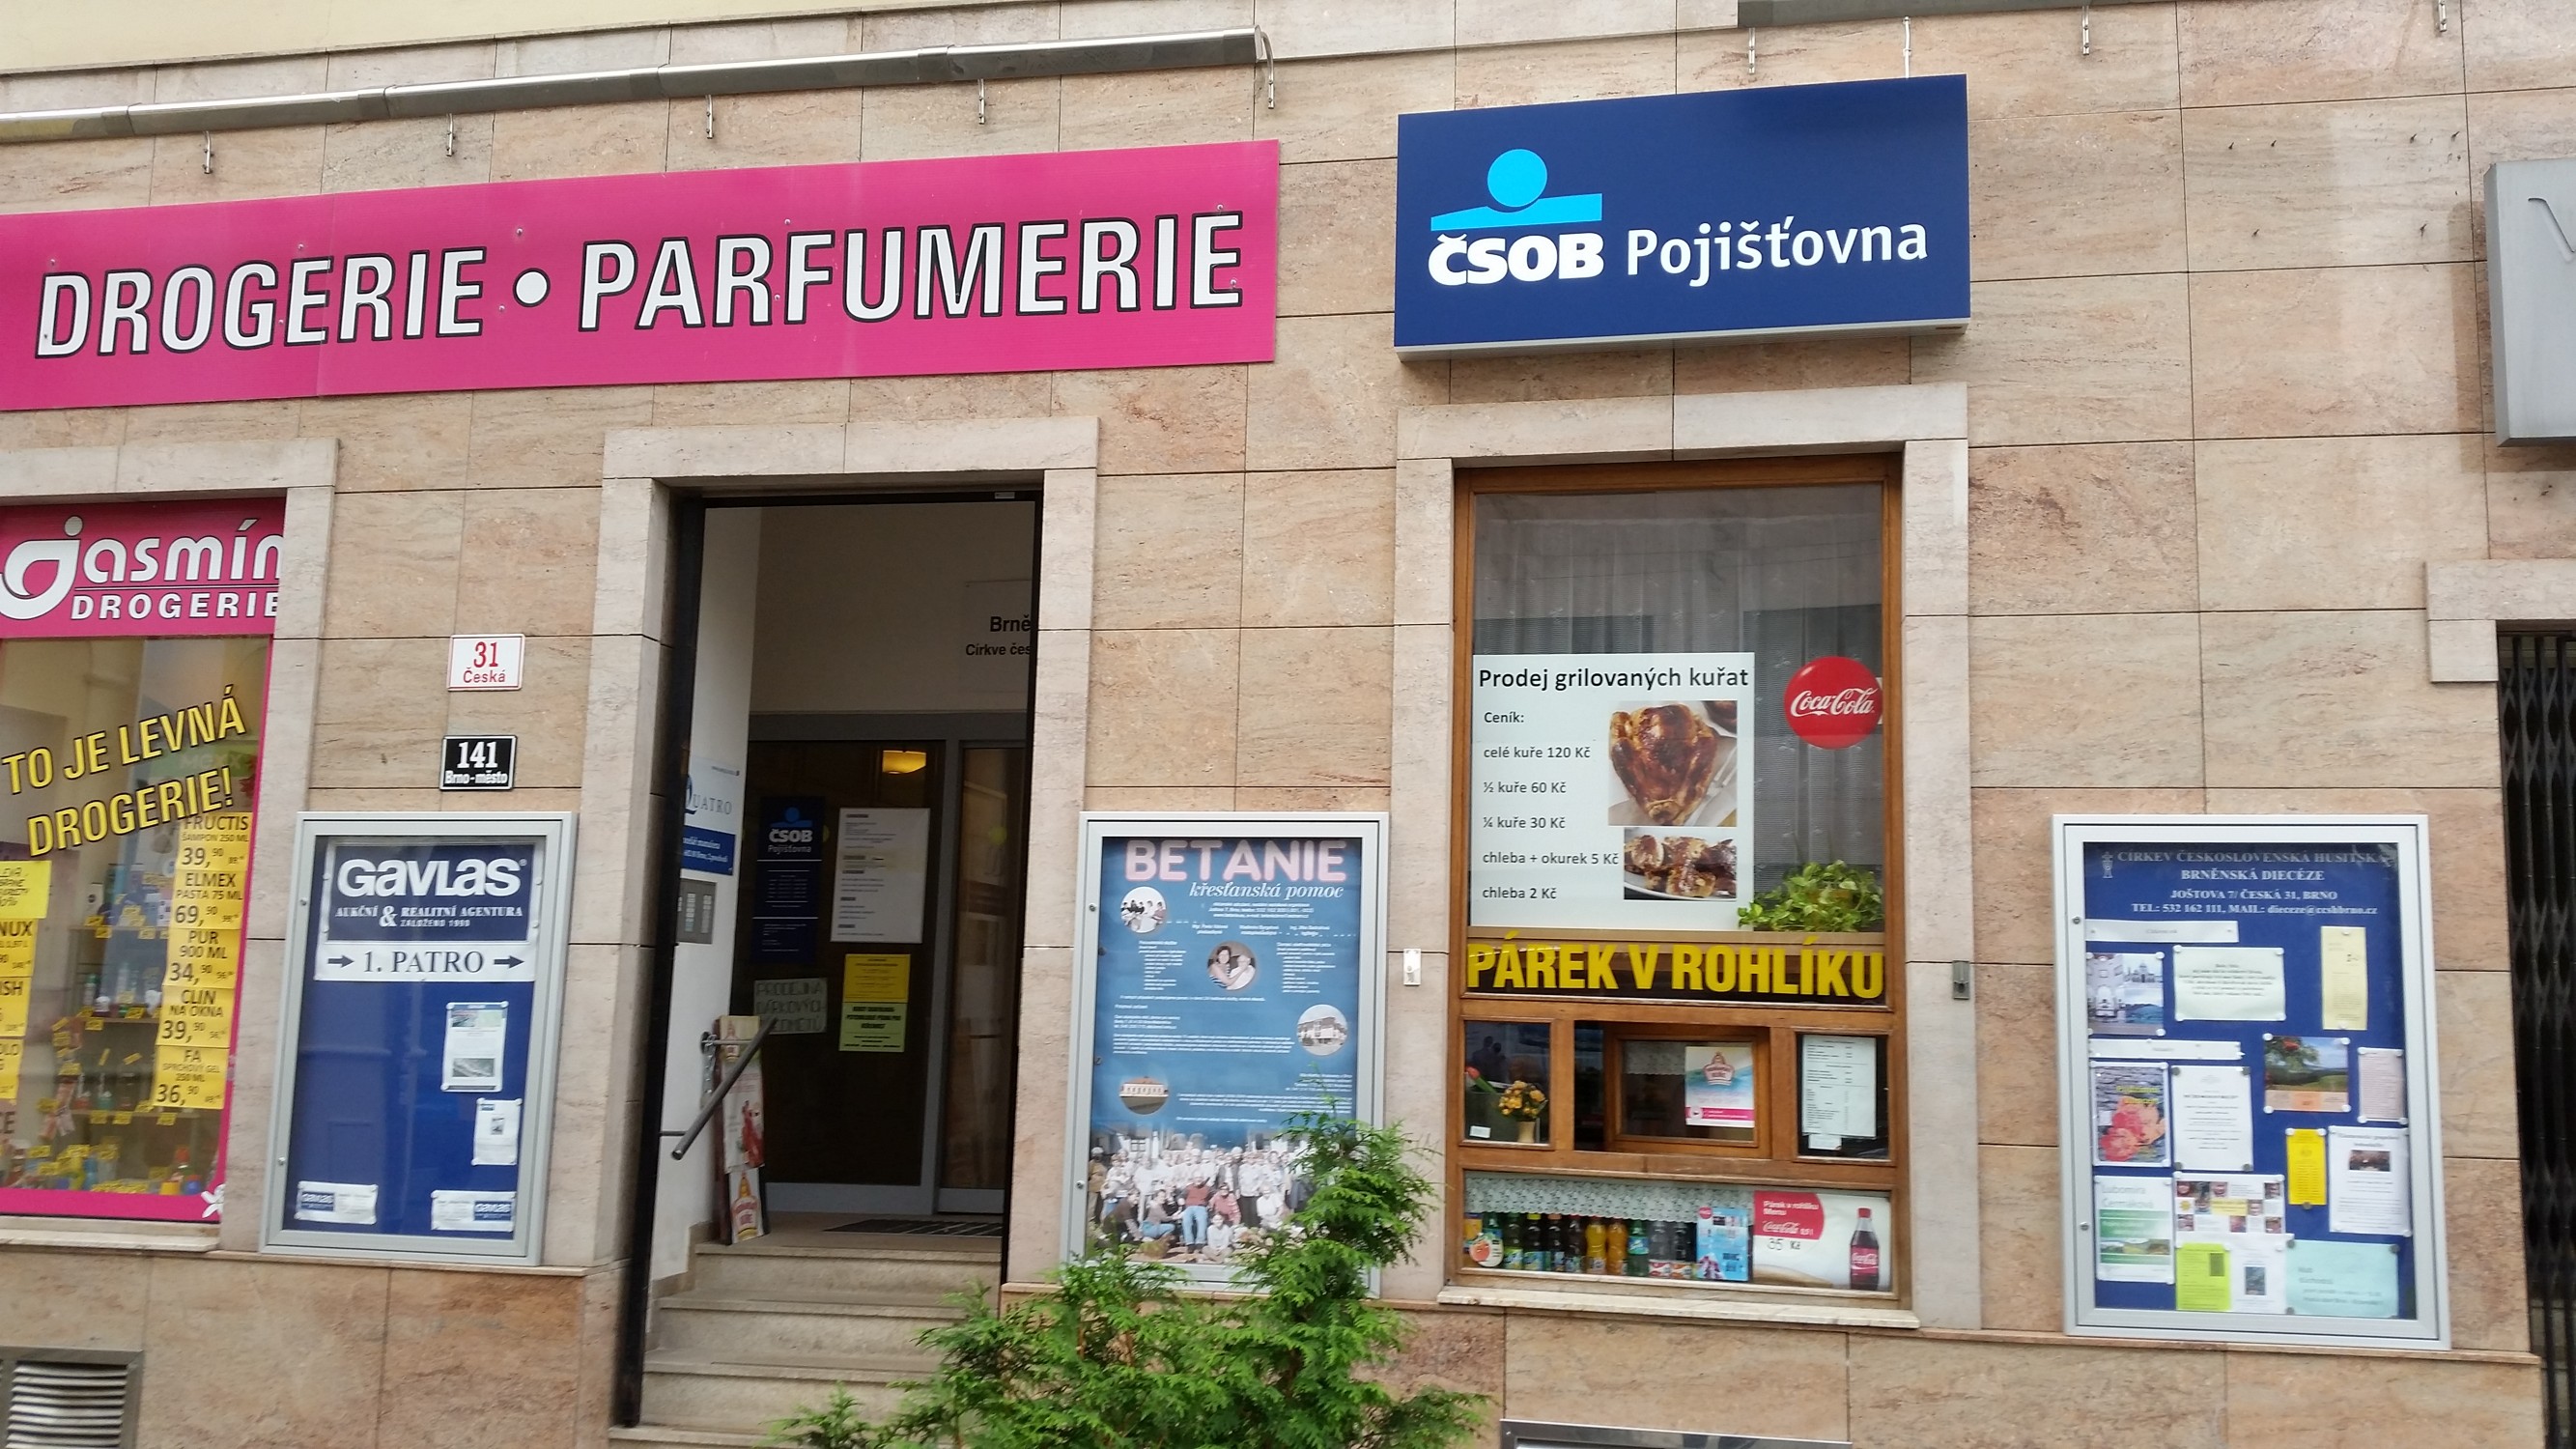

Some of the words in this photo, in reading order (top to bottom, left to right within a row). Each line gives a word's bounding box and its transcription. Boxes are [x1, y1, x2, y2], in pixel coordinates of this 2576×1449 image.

[1429, 233, 1604, 286] ČSOB
[1628, 216, 1928, 287] Pojišťovna
[35, 245, 486, 358] DROGERIE
[578, 211, 1243, 331] PARFUMERIE
[71, 591, 278, 620] DROGERIE
[473, 641, 499, 668] 31
[463, 668, 506, 684] Česká
[1479, 668, 1549, 692] Prodej
[1555, 667, 1682, 692] grilovaných
[1689, 667, 1749, 687] kuřat
[1791, 688, 1879, 717] Coca-Cola
[1484, 711, 1524, 724] Ceník:
[2, 746, 53, 795] TO
[64, 731, 110, 781] JE
[118, 684, 247, 766] LEVNÁ
[457, 741, 498, 769] 141
[1484, 747, 1511, 758] celé
[1514, 747, 1543, 758] kuře
[1547, 747, 1571, 758] 120
[1575, 746, 1592, 758] Kč
[1498, 781, 1527, 793] kuře
[1531, 781, 1547, 793] 60
[1551, 781, 1567, 793] Kč
[27, 766, 235, 857] DROGERIE!
[184, 815, 249, 831] FRUCTIS
[1497, 816, 1526, 828] kuře
[1530, 817, 1546, 828] 30
[1550, 816, 1566, 828] Kč
[769, 828, 813, 842] ČSOB
[1125, 838, 1348, 882] BETANIE
[1483, 852, 1526, 863] chleba
[1542, 852, 1588, 864] okurek
[1591, 853, 1599, 864] 5
[1603, 852, 1619, 864] Kč
[2117, 849, 2172, 862] CÍRKEV
[2175, 849, 2311, 864] ČESKOSLOVENSKÁ
[185, 872, 237, 887] ELMEX
[2180, 867, 2259, 880] BRNĚNSKÁ
[2261, 867, 2326, 881] DIECÉZE
[176, 889, 210, 899] PASTA
[212, 890, 224, 899] 75
[226, 891, 243, 900] ML
[1189, 881, 1282, 898] křesťanská
[1284, 885, 1345, 901] pomoc
[1483, 887, 1526, 898] chleba
[1529, 888, 1538, 898] 2
[1542, 887, 1557, 898] Kč
[2169, 888, 2226, 899] JOŠTOVA
[2239, 888, 2282, 900] ČESKÁ
[2302, 891, 2338, 900] BRNO
[379, 905, 399, 927] &
[400, 904, 457, 918] REALITNÍ
[460, 906, 524, 918] AGENTURA
[2162, 903, 2182, 913] 532
[2184, 903, 2203, 913] 162
[187, 930, 219, 945] PUR
[180, 945, 203, 958] 900
[207, 947, 228, 959] ML
[364, 952, 382, 973] 1.
[390, 950, 486, 974] PATRO
[1467, 930, 1620, 990] PÁREK
[1628, 943, 1660, 990] V
[1671, 935, 1885, 1000] ROHLÍKU
[181, 989, 216, 1005] CLIN
[170, 1006, 187, 1016] NA
[190, 1006, 224, 1017] OKNA
[184, 1049, 202, 1063] FA
